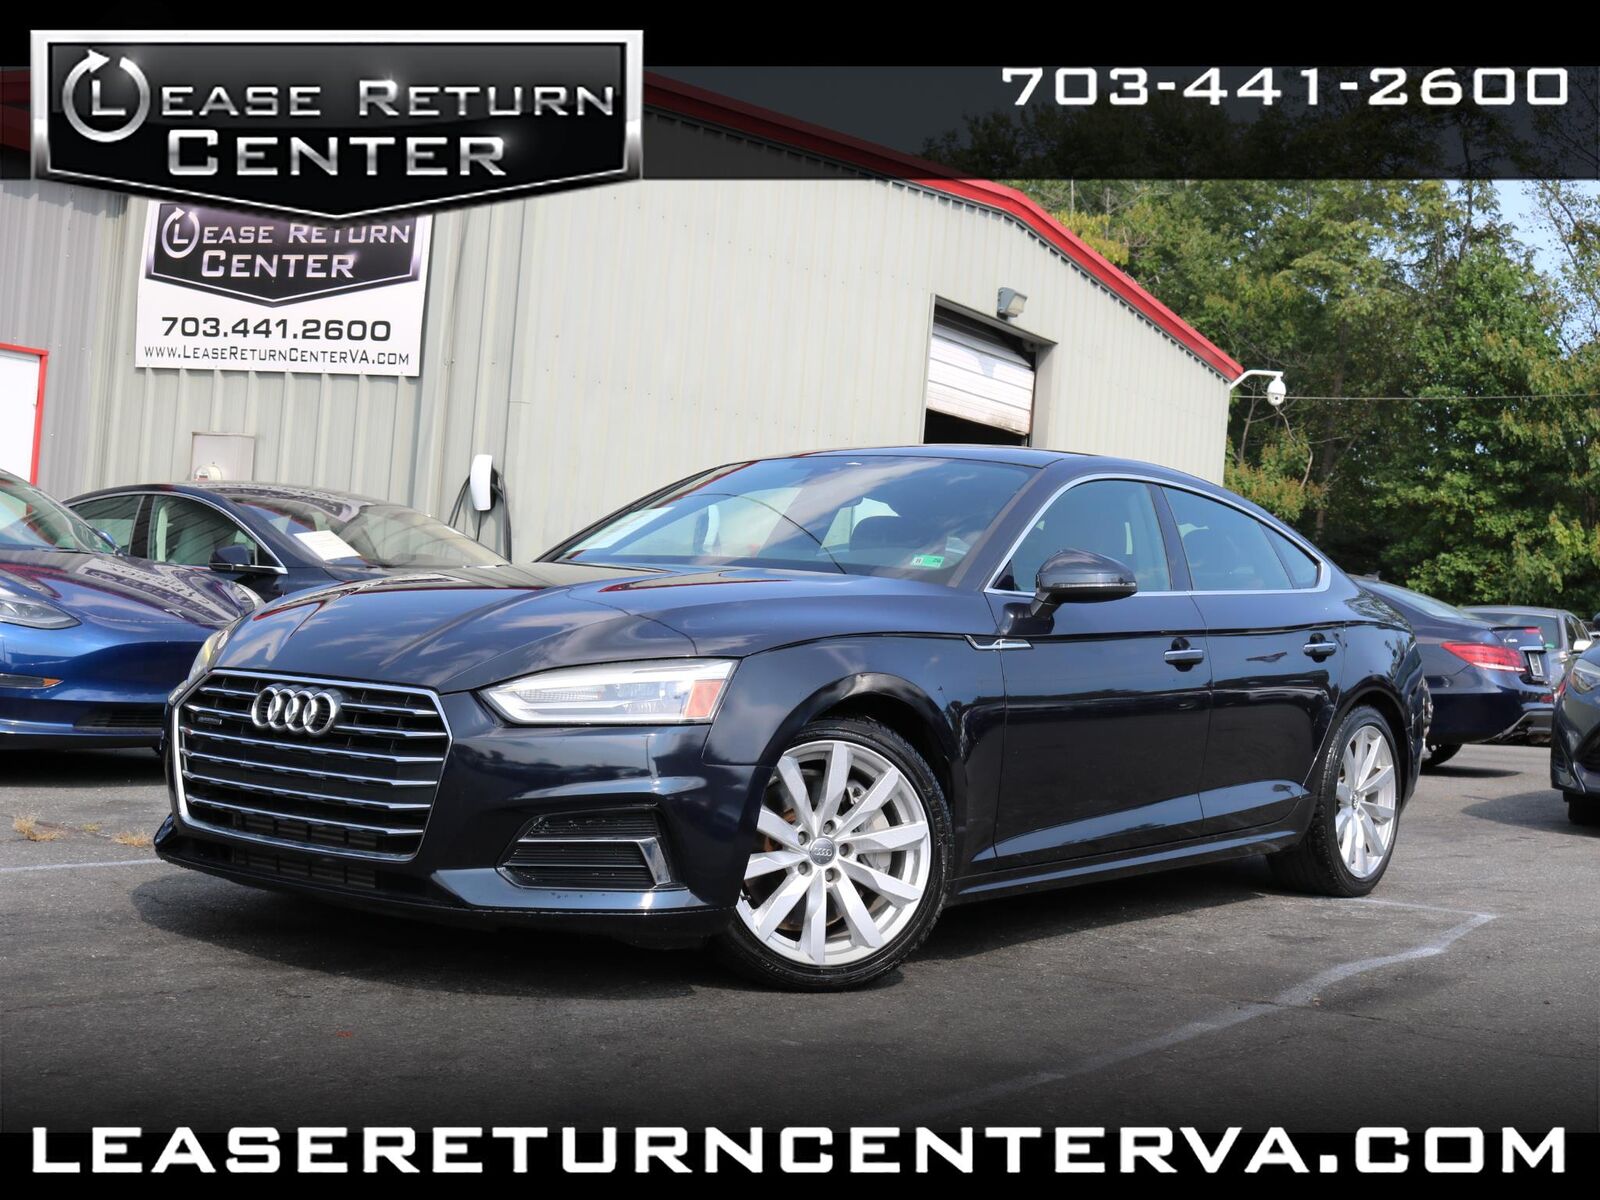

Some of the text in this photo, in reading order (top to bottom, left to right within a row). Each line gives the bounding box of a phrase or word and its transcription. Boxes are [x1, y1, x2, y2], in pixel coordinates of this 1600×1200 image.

[173, 223, 274, 245] LEASE
[201, 250, 354, 278] CENTER
[162, 317, 390, 341] 703.441.2600
